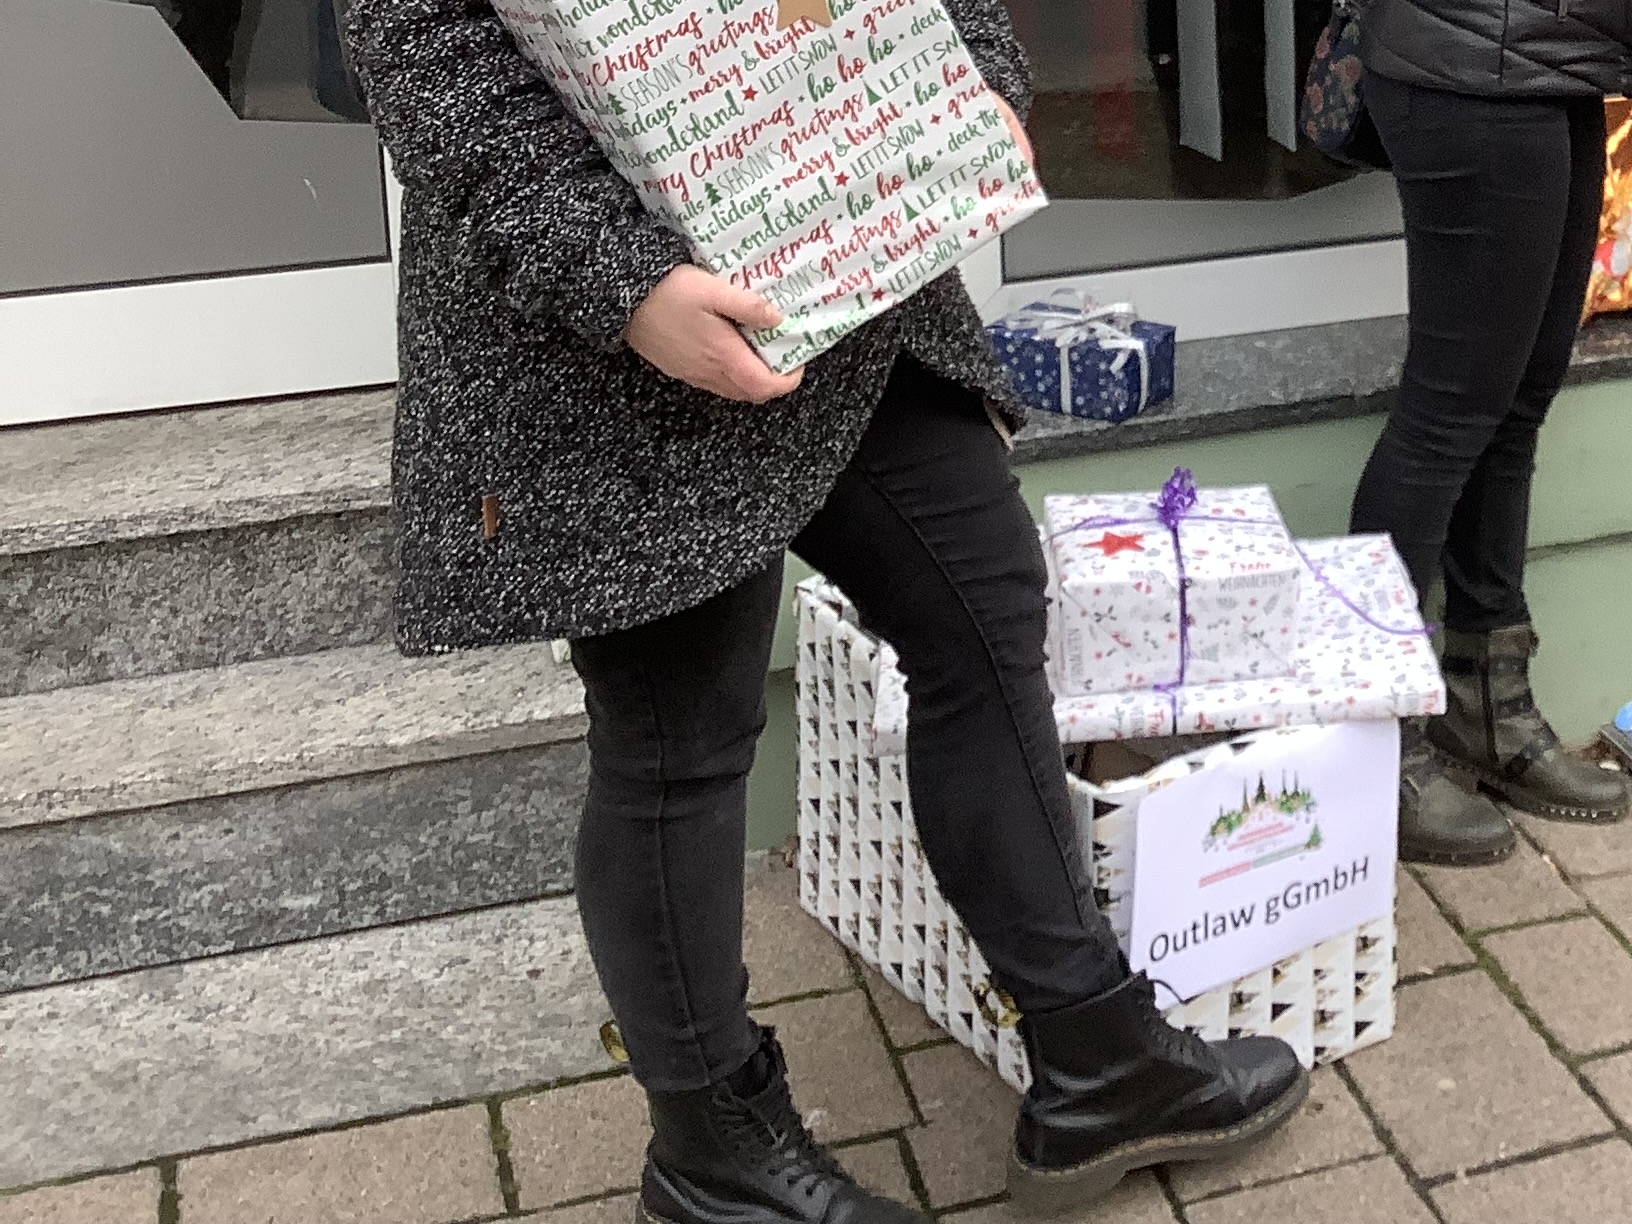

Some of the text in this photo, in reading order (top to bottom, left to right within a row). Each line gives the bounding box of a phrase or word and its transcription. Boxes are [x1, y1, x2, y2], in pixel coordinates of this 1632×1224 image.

[592, 11, 703, 87] Christmas
[688, 5, 775, 76] greetings
[688, 64, 744, 102] merry
[741, 50, 761, 71] &
[753, 15, 816, 61] bright
[797, 32, 838, 72] SNOW
[689, 100, 795, 178] Christmas
[807, 72, 838, 103] ho
[837, 53, 867, 84] ho
[867, 35, 897, 65] ho
[910, 6, 948, 37] deck
[780, 90, 865, 163] greetings
[880, 61, 911, 95] LET
[911, 48, 931, 75] IT
[782, 149, 836, 189] merry
[831, 136, 851, 158] &
[844, 100, 904, 148] bright
[913, 80, 942, 107] ho
[941, 62, 970, 88] ho
[887, 118, 926, 157] SNOW
[819, 206, 902, 280] greetings
[916, 176, 946, 210] LET
[946, 163, 968, 189] IT
[970, 131, 1016, 176] SNOW
[846, 191, 876, 221] ho
[876, 171, 906, 201] ho
[905, 152, 936, 182] ho
[947, 123, 986, 153] deck
[821, 266, 874, 305] merry
[870, 252, 889, 274] &
[883, 216, 942, 263] bright
[949, 194, 978, 221] ho
[977, 176, 1005, 200] ho
[923, 233, 963, 271] SNOW
[1149, 902, 1256, 962] Outlaw
[1264, 856, 1370, 925] gGmbH
